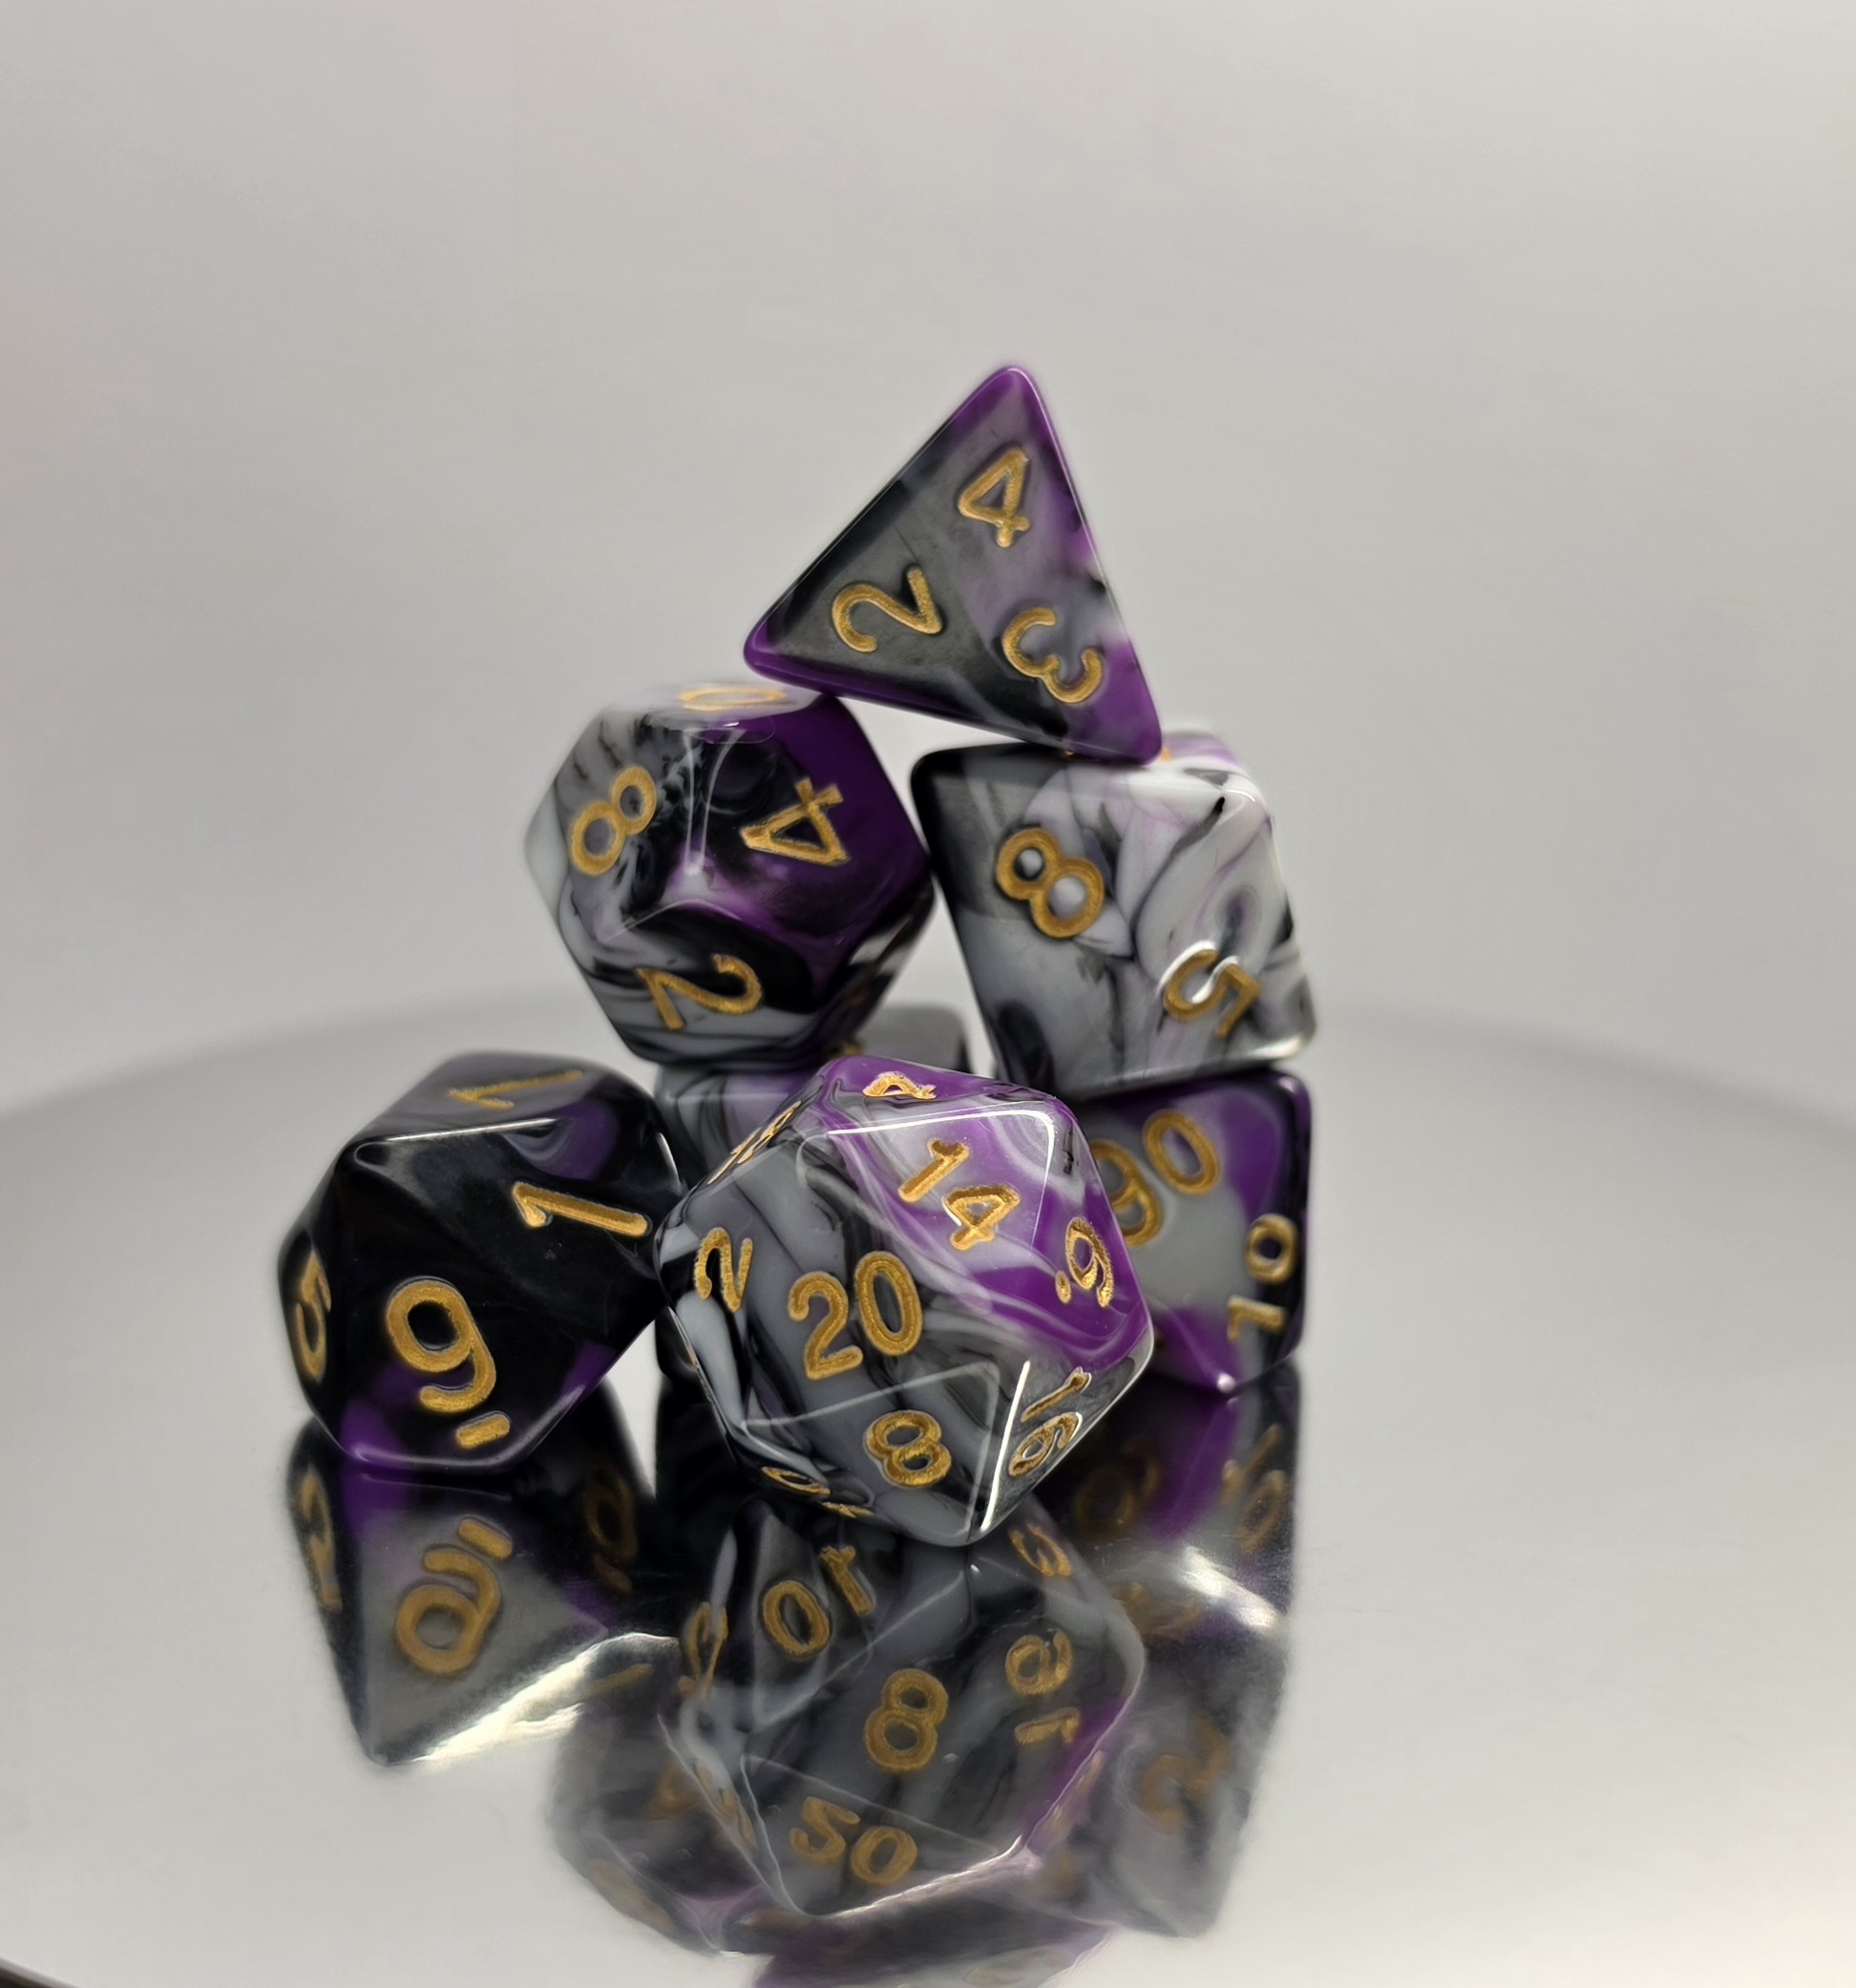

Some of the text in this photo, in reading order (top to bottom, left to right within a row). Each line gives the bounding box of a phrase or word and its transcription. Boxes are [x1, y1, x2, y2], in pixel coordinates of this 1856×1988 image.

[958, 445, 1032, 549] 4
[831, 566, 945, 654] 2
[1001, 605, 1105, 706] 3
[572, 766, 658, 876] 8
[739, 777, 850, 866] 4
[996, 827, 1106, 940] 8
[635, 954, 764, 1031] 2
[1163, 947, 1261, 1039] 5
[897, 1136, 1022, 1251] 14
[693, 1226, 753, 1313] 2
[786, 1250, 923, 1381] 20
[1227, 1211, 1299, 1344] 10
[864, 1408, 953, 1488] 8
